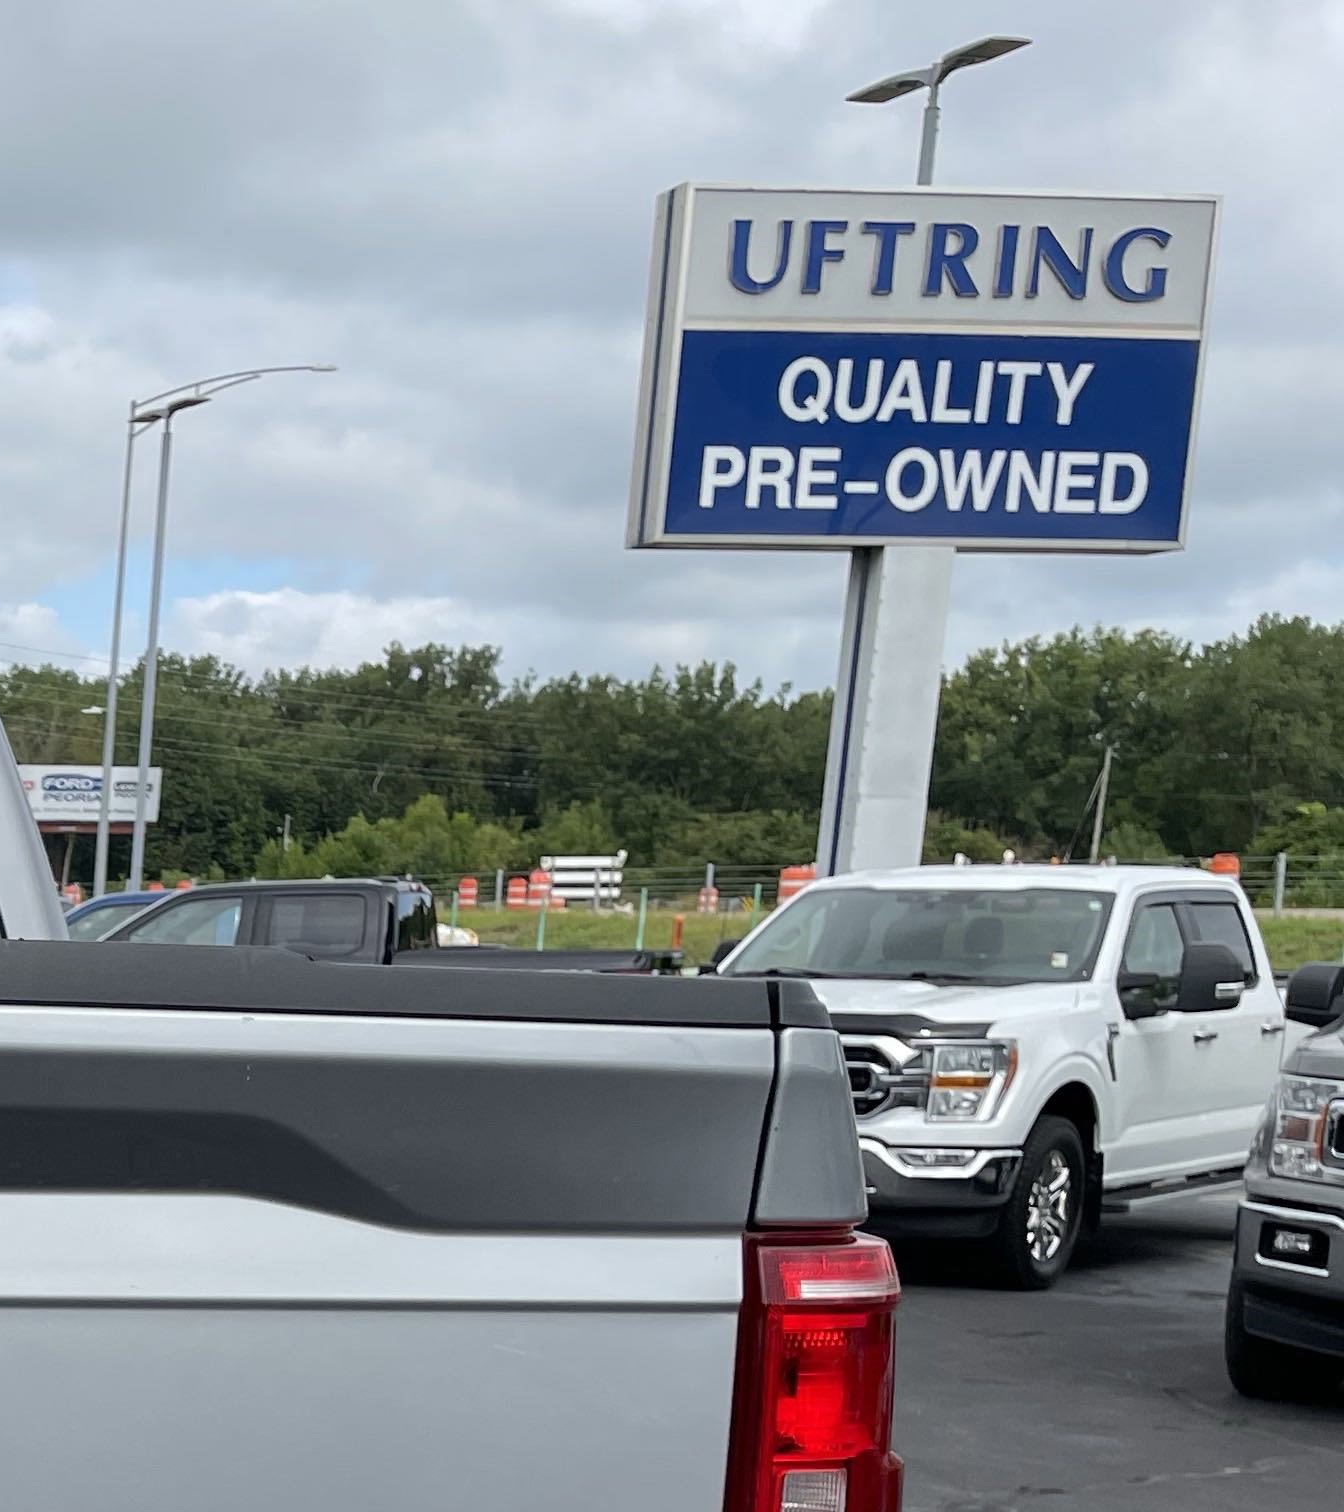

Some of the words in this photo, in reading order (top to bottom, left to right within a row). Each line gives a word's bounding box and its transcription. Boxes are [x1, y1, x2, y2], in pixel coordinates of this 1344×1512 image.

[727, 218, 1173, 302] UFTRING
[778, 356, 1095, 426] QUALITY
[698, 445, 1150, 515] PRE-OWNED
